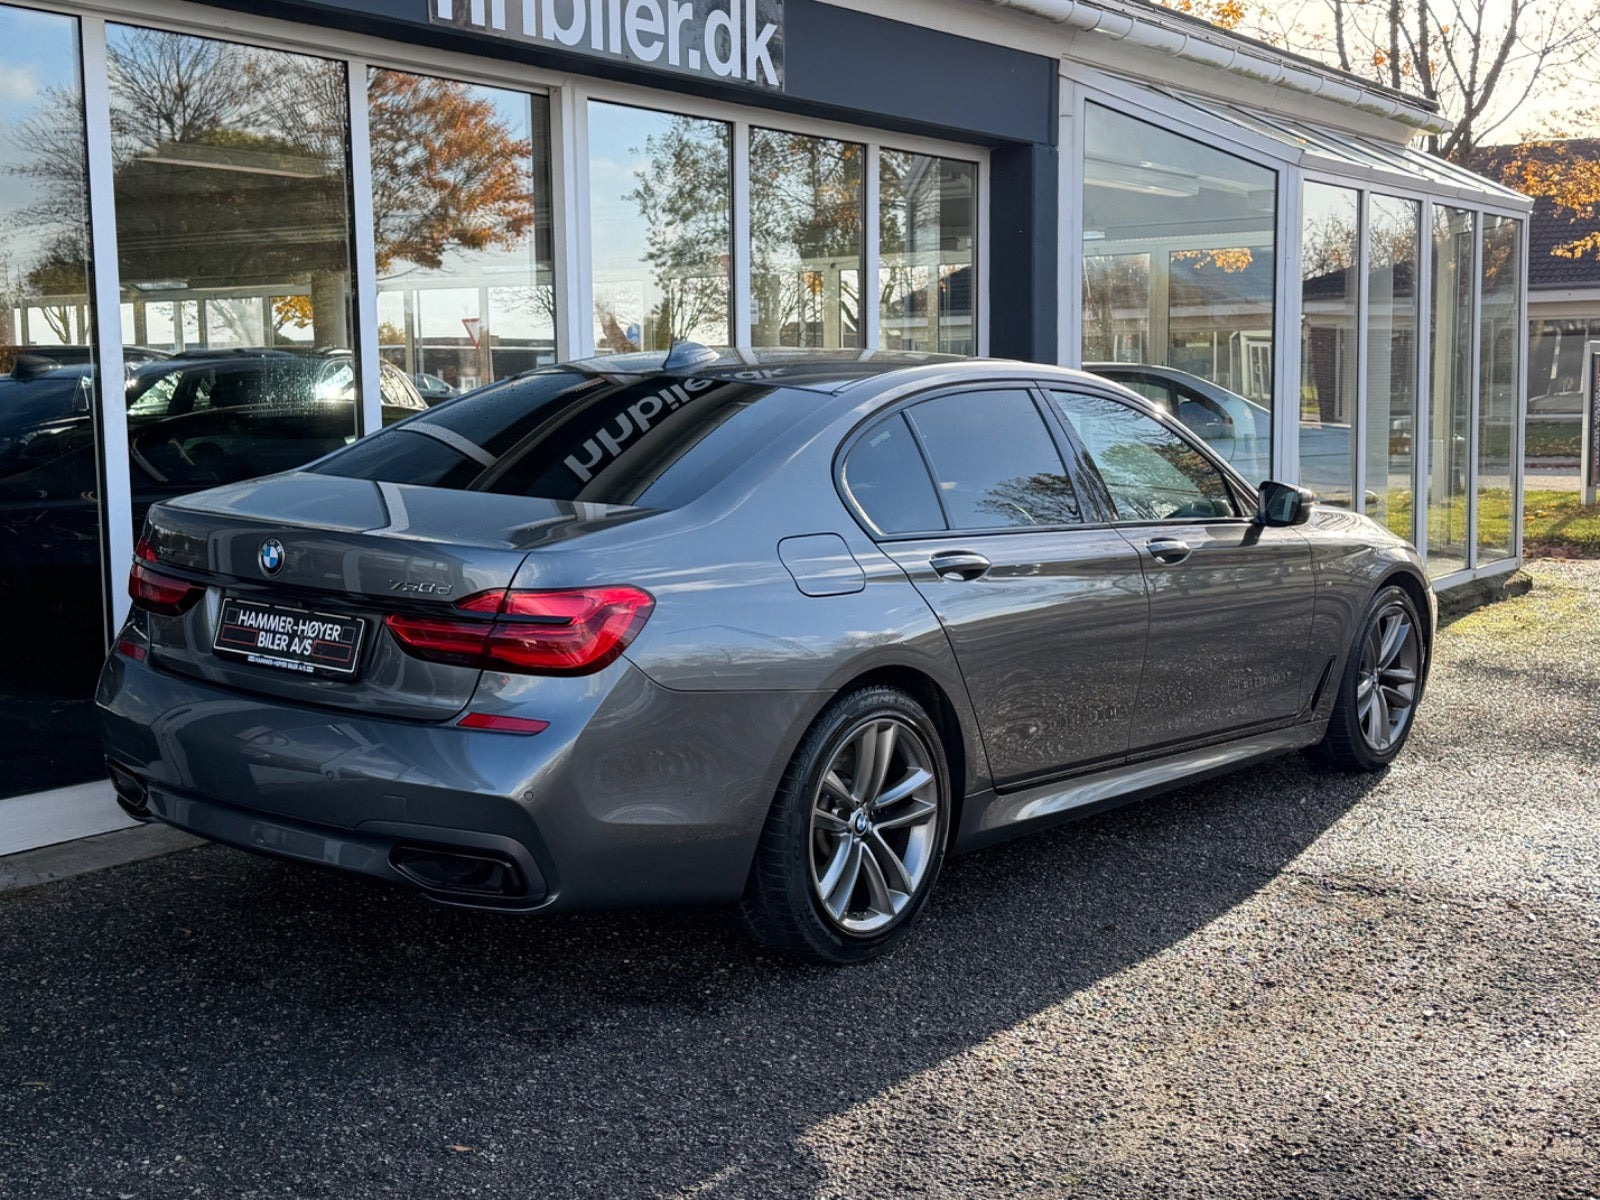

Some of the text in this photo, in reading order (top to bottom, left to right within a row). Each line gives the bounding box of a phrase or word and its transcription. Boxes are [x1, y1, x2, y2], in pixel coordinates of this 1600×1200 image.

[437, 0, 780, 86] biler.dk
[237, 609, 341, 641] HAMMER-HØYER
[257, 631, 313, 656] BILER A/S
